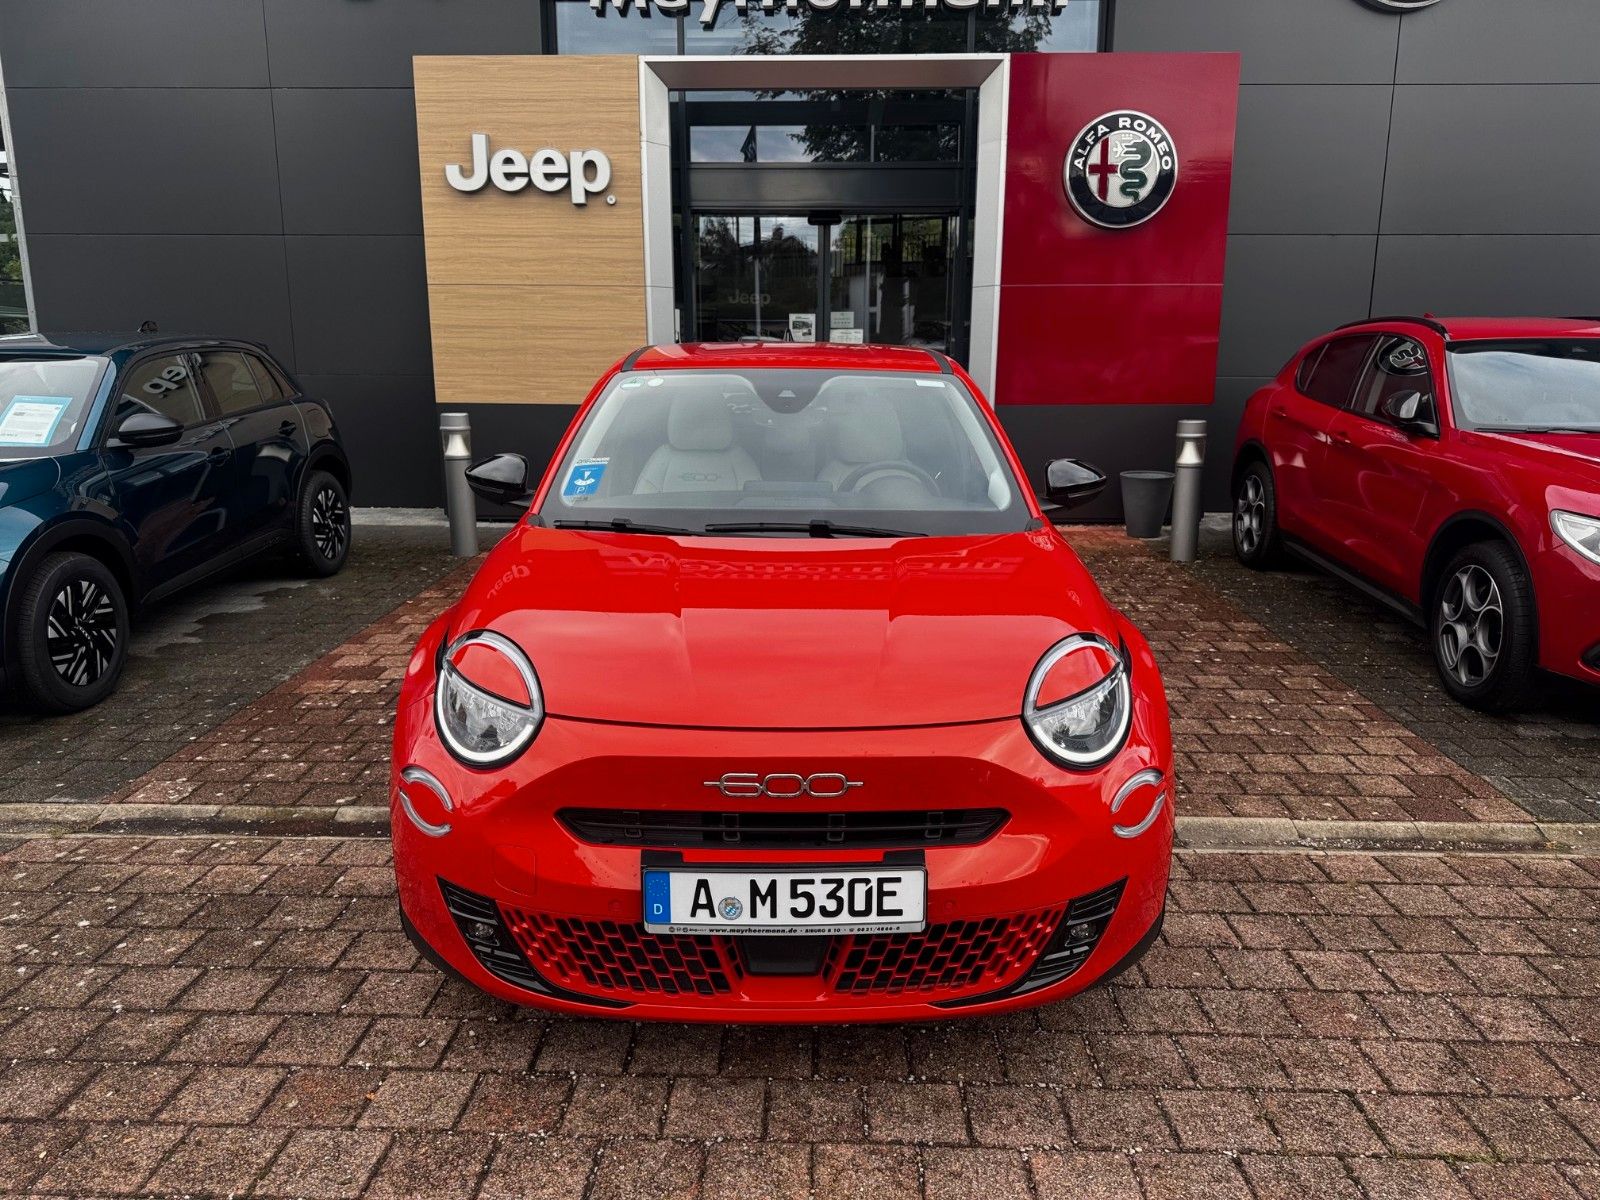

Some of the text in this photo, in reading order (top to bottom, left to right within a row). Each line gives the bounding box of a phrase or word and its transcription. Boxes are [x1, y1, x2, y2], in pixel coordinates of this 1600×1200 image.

[1073, 117, 1173, 170] ALFA ROMEO
[445, 133, 612, 206] Jeep
[727, 288, 771, 308] Jeep
[712, 772, 855, 798] 600
[653, 903, 663, 915] D
[689, 876, 904, 918] A M 530E
